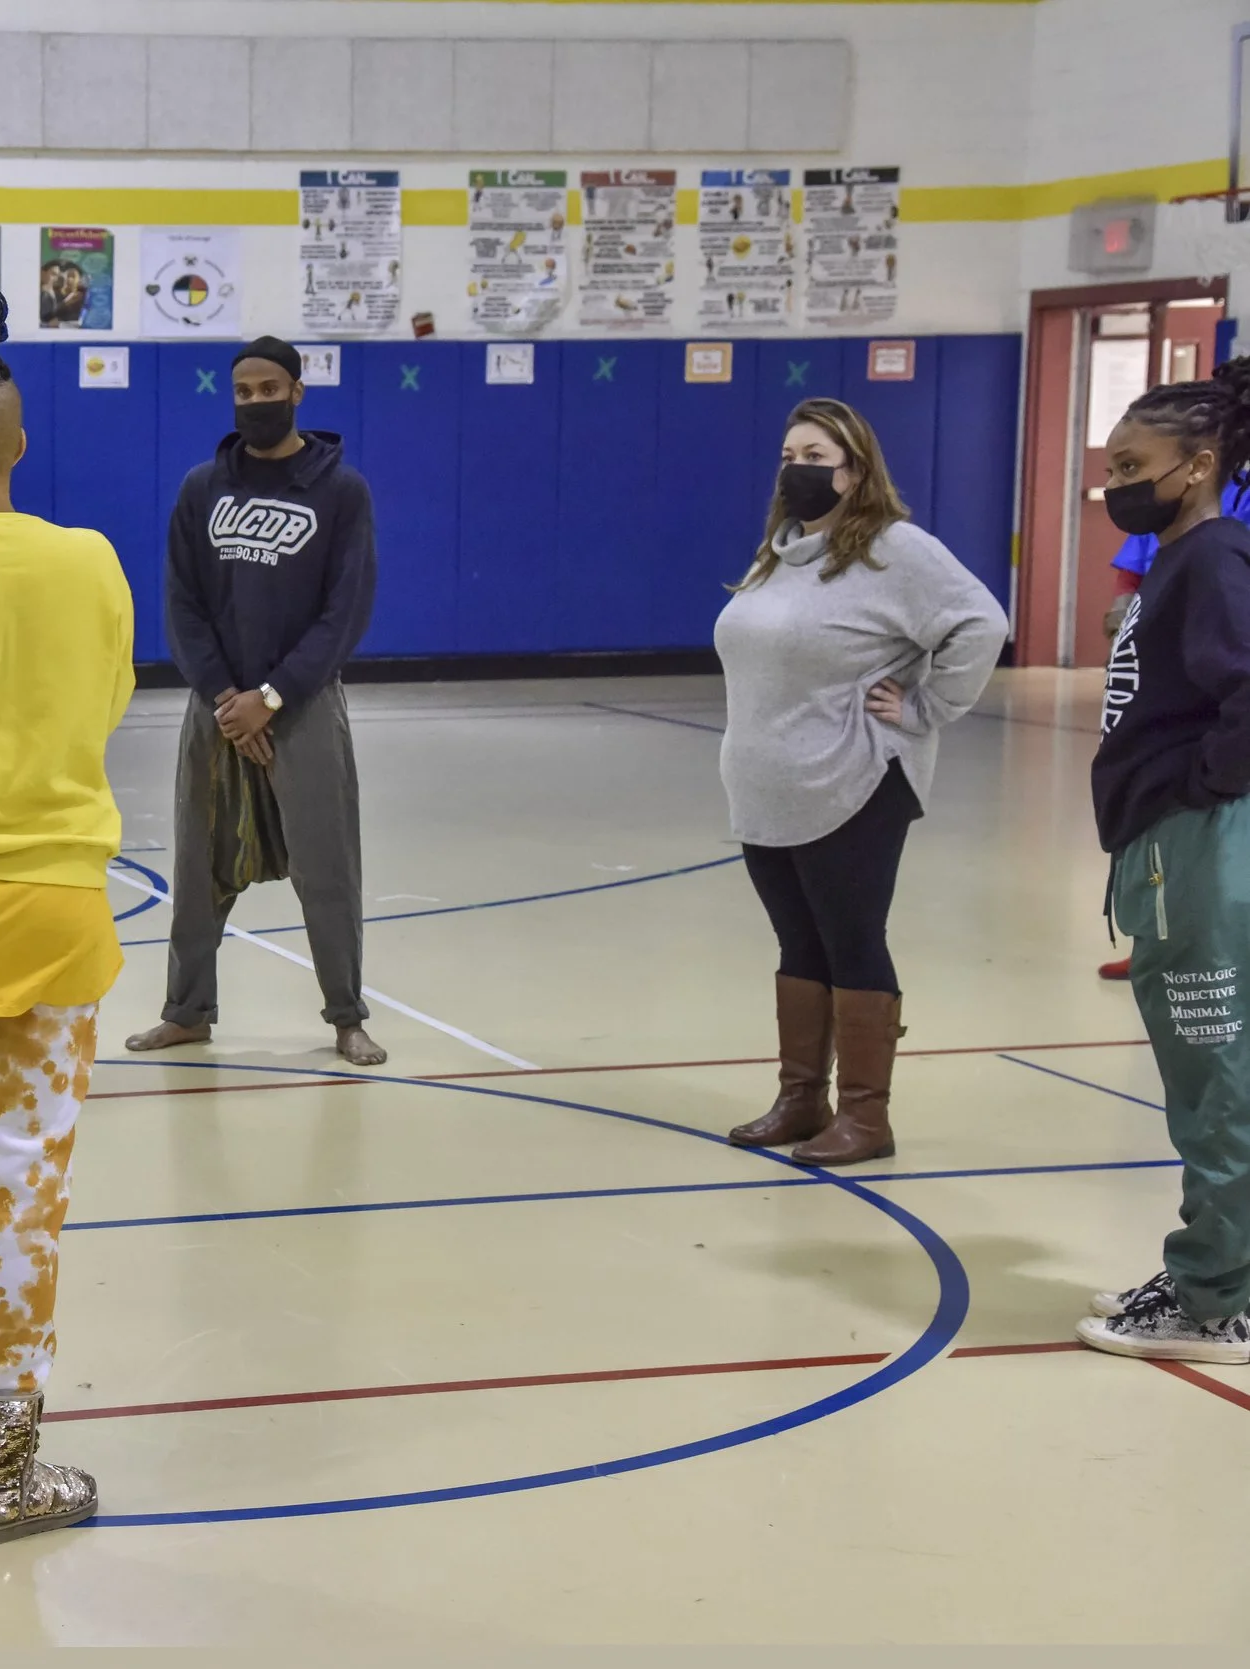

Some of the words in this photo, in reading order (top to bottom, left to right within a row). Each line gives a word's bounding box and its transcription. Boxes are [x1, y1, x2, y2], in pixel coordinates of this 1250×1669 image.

[210, 496, 312, 546] WCDB
[236, 546, 260, 562] 90.9
[1162, 967, 1237, 985] NOSTALGIC
[1166, 985, 1237, 1002] OBJECTIVE
[1170, 1005, 1231, 1019] MINIMAL
[1174, 1020, 1243, 1036] AESTHETIC
